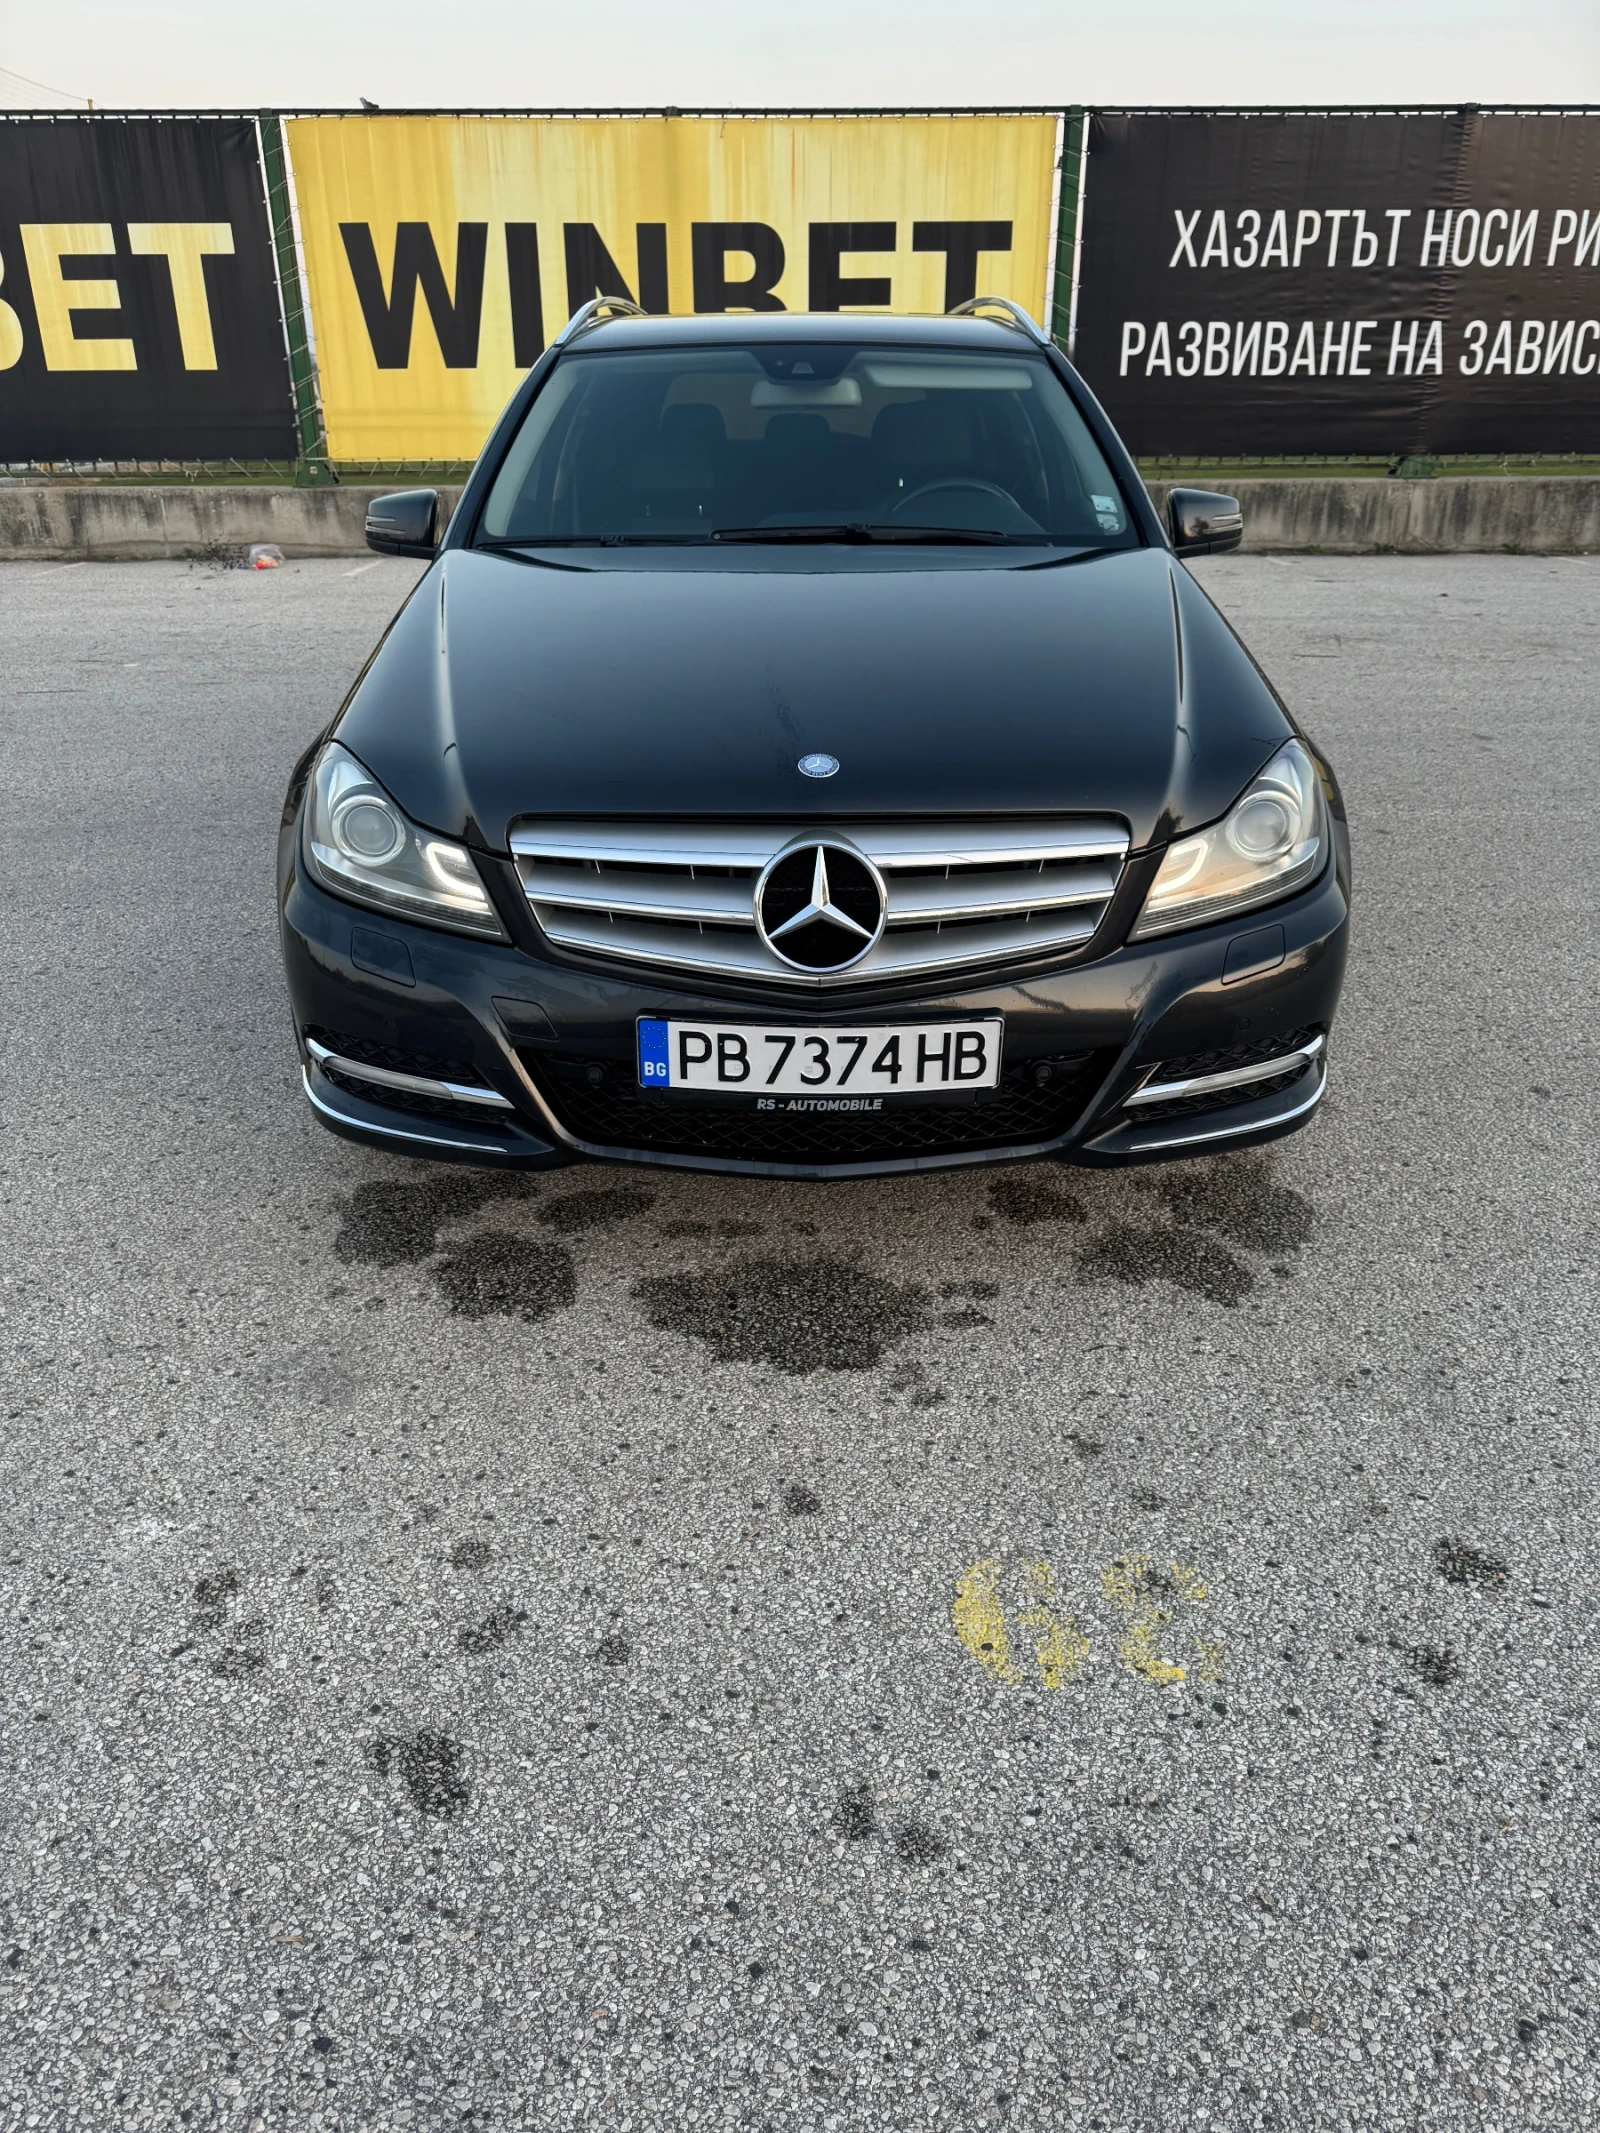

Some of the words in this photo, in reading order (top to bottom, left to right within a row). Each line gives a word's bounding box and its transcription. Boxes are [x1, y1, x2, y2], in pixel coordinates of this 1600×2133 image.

[1168, 208, 1411, 268] ХАЗАРТЪТ
[1419, 207, 1540, 268] НОСИ
[0, 222, 236, 372] ET
[338, 220, 1014, 369] WINBET
[1118, 319, 1378, 377] РАЗВИВАНЕ
[1386, 319, 1444, 376] НА
[1458, 318, 1600, 376] ЗАВИС
[643, 1061, 667, 1077] BG
[678, 1030, 752, 1084] PB
[763, 1034, 904, 1086] 7374
[915, 1030, 988, 1084] HB
[756, 1098, 776, 1110] RS
[786, 1098, 884, 1111] AUTOMOBILE
